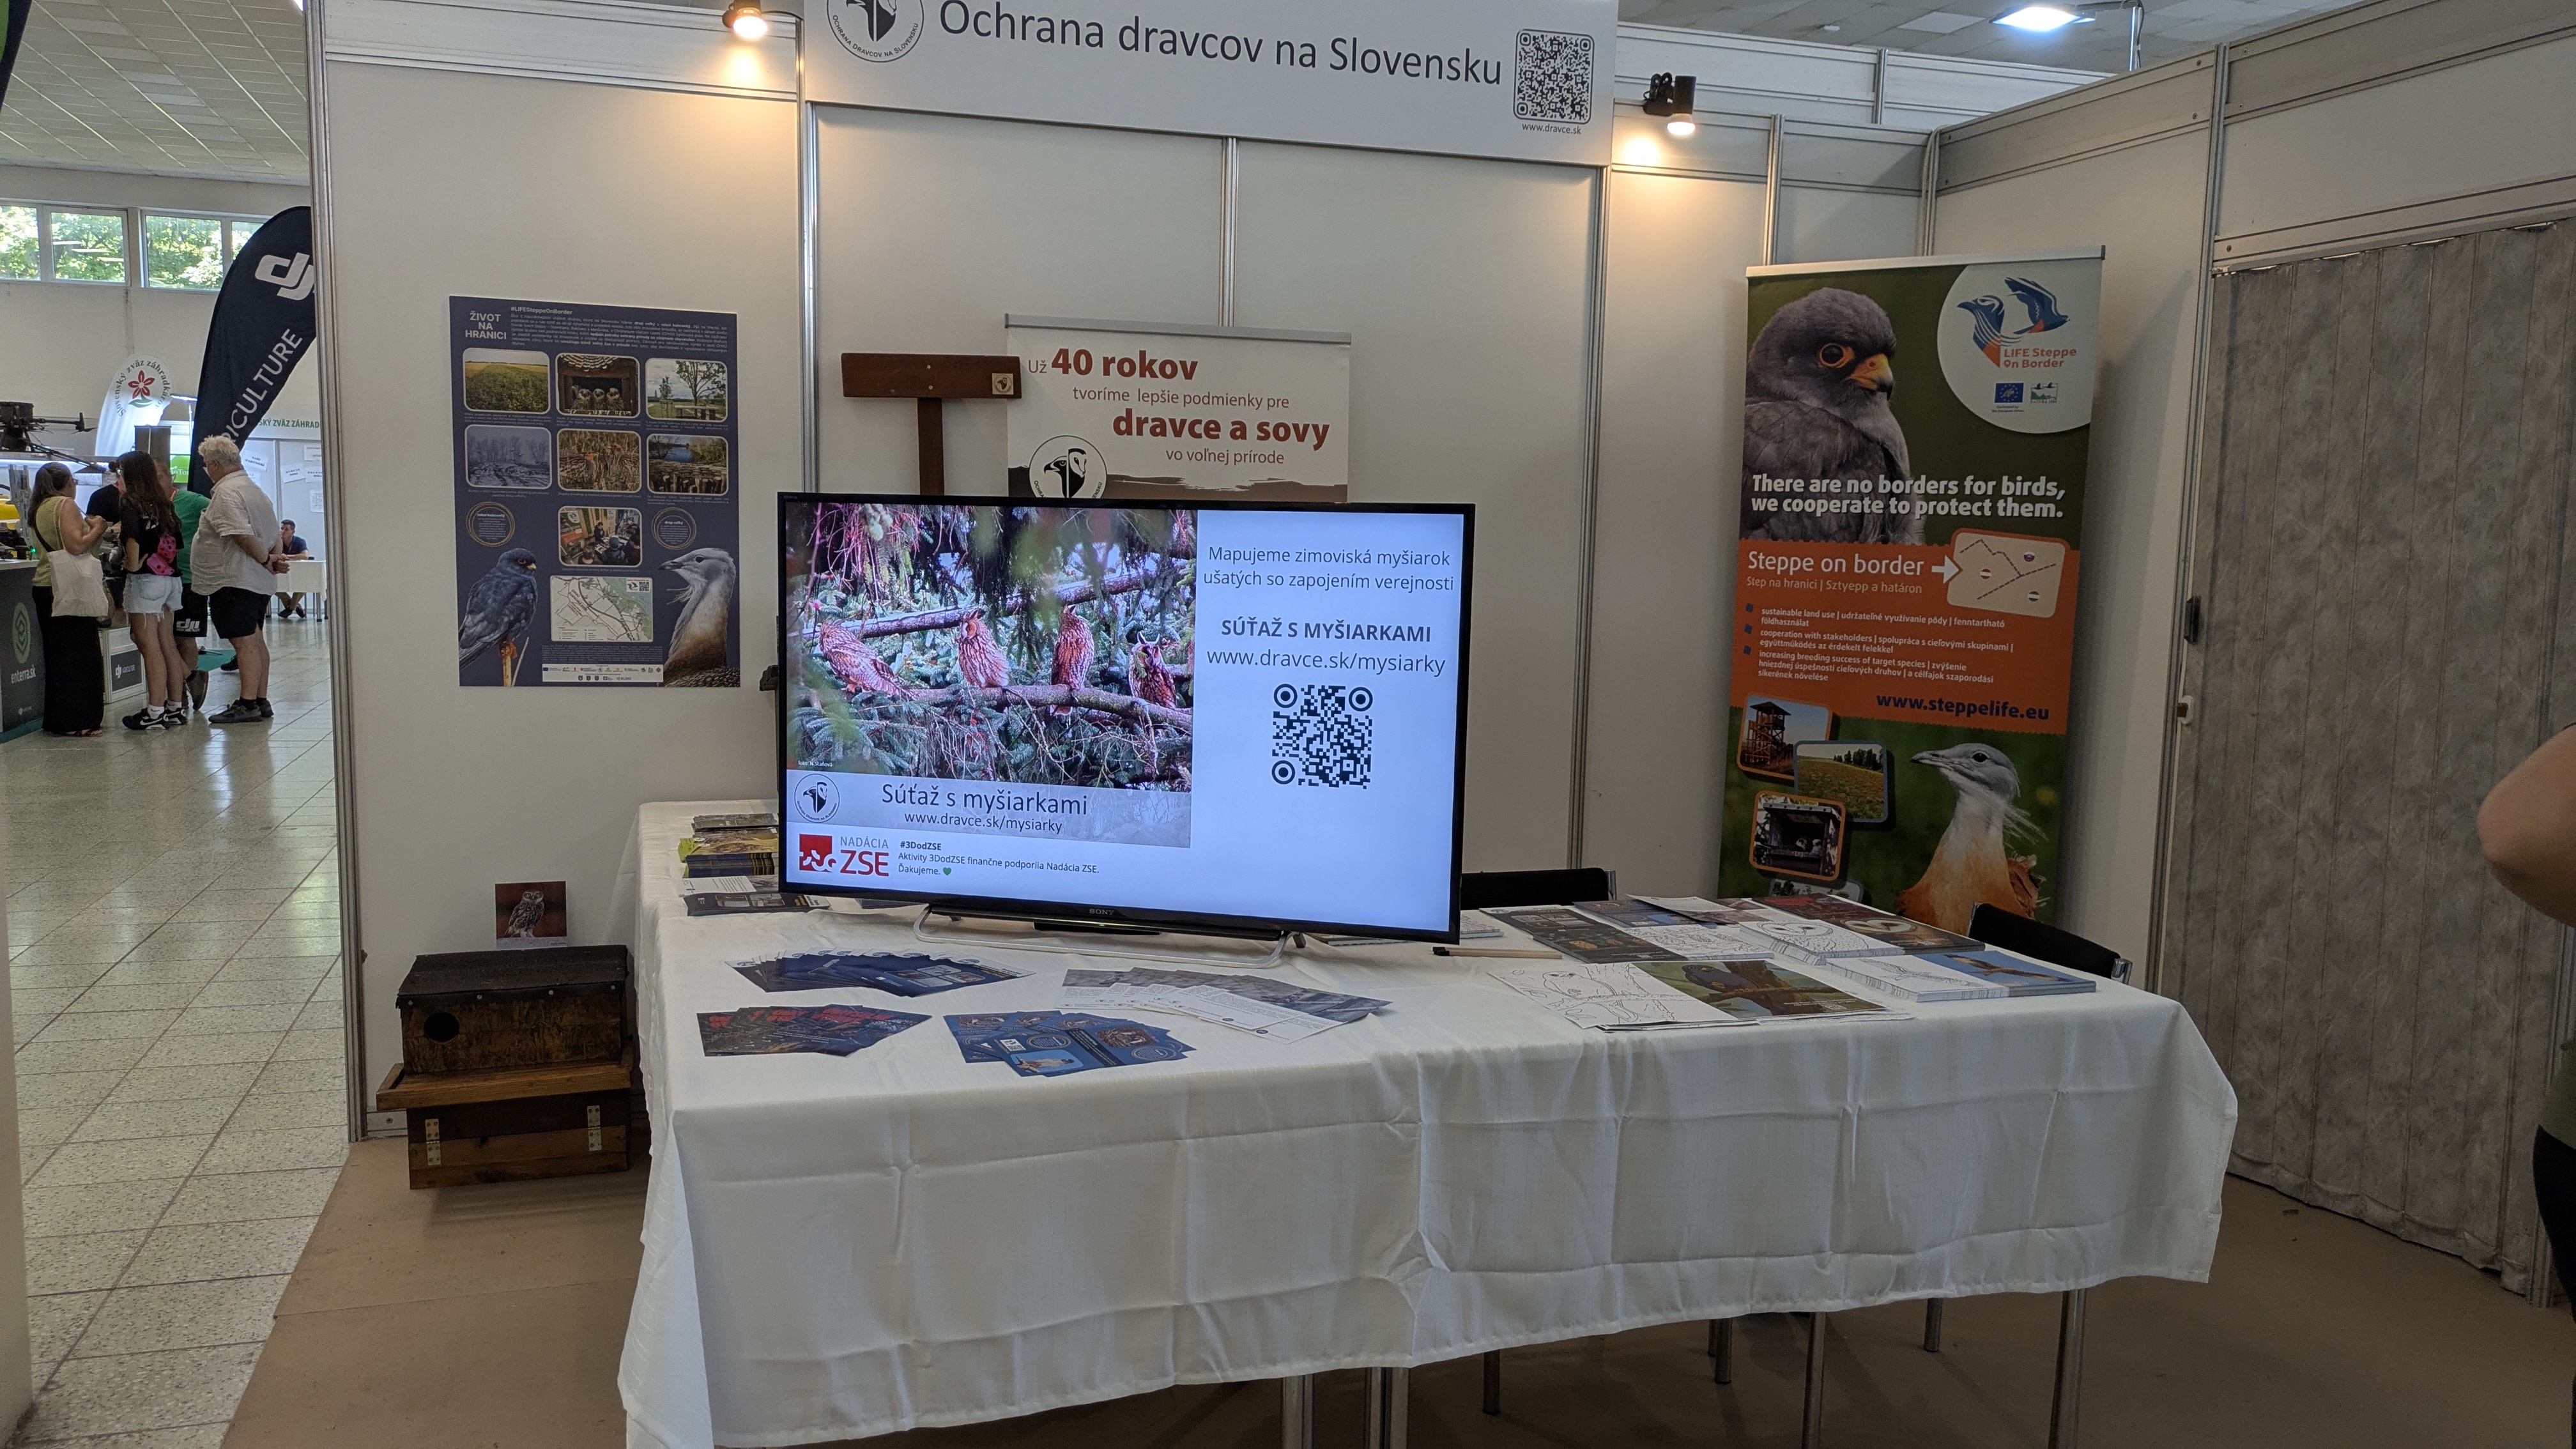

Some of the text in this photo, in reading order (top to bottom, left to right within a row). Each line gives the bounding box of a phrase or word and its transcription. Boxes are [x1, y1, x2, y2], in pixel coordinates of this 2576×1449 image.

[832, 15, 852, 45] OCHRANA
[852, 43, 882, 57] DRAVCOV
[894, 22, 919, 54] SLOVENSKU
[940, 0, 1501, 84] Ochrana dravcov na Slovensku
[1522, 123, 1582, 135] www.dravce.sk
[470, 310, 501, 322] ŽIVOT
[511, 306, 572, 315] #LIFESteppeOnBorder
[465, 330, 507, 339] HRANICI
[479, 322, 493, 330] NA
[2004, 348, 2076, 358] LIFE Steppe
[2004, 358, 2064, 368] On Border
[126, 360, 144, 373] zväz
[1028, 348, 1199, 380] Už 40 rokov
[1073, 386, 1289, 411] tvoríme lepšie podmienky pre
[259, 418, 319, 428] SKÝ ZVÄZ ZÁHRAD
[1112, 408, 1330, 451] dravce a sovy
[1166, 448, 1284, 466] vo voľnej prírode
[1034, 480, 1103, 498] OCHRA ENSKU
[1752, 473, 2066, 500] There are no borders for birds,
[1751, 496, 2064, 519] we cooperate to protect them.
[1209, 546, 1450, 568] Mapujeme zimoviská myšiarok
[1749, 551, 1924, 576] Steppe on border
[1204, 570, 1454, 593] ušatých so zapojením verejnosti
[1747, 576, 1766, 588] Step
[1769, 579, 1781, 587] na
[1784, 578, 1817, 589] hranici
[1826, 580, 1868, 593] Sztyepp
[1882, 581, 1922, 594] határon
[1761, 608, 1802, 617] sustainable
[1804, 609, 1820, 617] land
[1841, 612, 1882, 620] udržateľné
[1885, 614, 1926, 624] využívanie
[1928, 616, 1948, 625] pôdy
[1954, 617, 2005, 627] fenntartható
[1761, 617, 1809, 627] földhasználat
[1221, 616, 1431, 642] SÚŤAŽ S MYŠIARKAMI
[1761, 629, 1803, 639] cooperation
[1804, 631, 1821, 640] with
[1823, 632, 1873, 642] stakeholders
[1878, 635, 1919, 645] spolupráca
[1967, 640, 2009, 651] skupinami
[1828, 642, 1860, 652] érdekelt
[1862, 644, 1894, 654] felekkel
[1207, 648, 1446, 677] www.dravce.sk/mysiarky
[1759, 650, 1795, 661] increasing
[1797, 652, 1830, 663] breeding
[1872, 657, 1896, 666] target
[1897, 659, 1926, 669] species
[1931, 661, 1966, 671] zvýšenie
[11, 664, 36, 684] enterra.sk
[1758, 670, 1793, 679] sikerének
[1759, 659, 1793, 670] hniezdnej
[1874, 667, 1901, 677] druhov
[1914, 670, 1944, 680] célfajok
[1946, 673, 1993, 684] szaporodási
[1876, 695, 2050, 720] www.steppelife.eu
[882, 783, 1087, 815] Súťaž s myšiarkami
[904, 813, 1062, 834] www.dravce.sk/mysiarky
[840, 836, 889, 849] NADÁCIA
[900, 841, 942, 851] #3DodZSE
[839, 849, 889, 877] ZSE
[898, 852, 1100, 873] Aktivity 3DodZSE finančne podporila Nadácia ZSE.
[898, 864, 941, 876] Ďakujeme.
